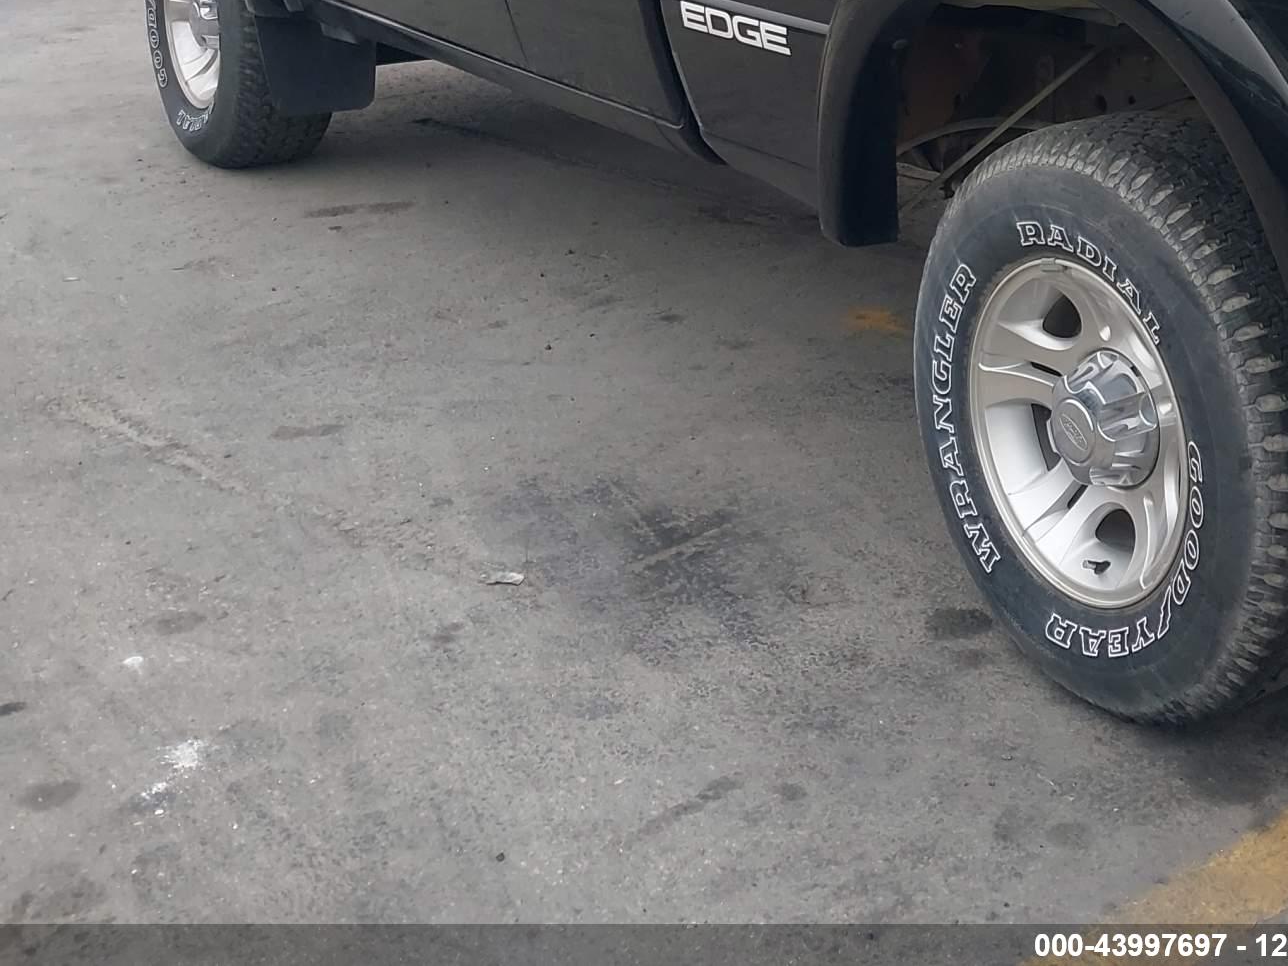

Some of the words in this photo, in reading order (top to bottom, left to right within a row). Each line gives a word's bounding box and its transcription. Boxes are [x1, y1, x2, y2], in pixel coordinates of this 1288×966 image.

[680, 0, 791, 55] EDGE
[1016, 221, 1160, 346] RADIAL
[931, 263, 1001, 574] WRANGLER
